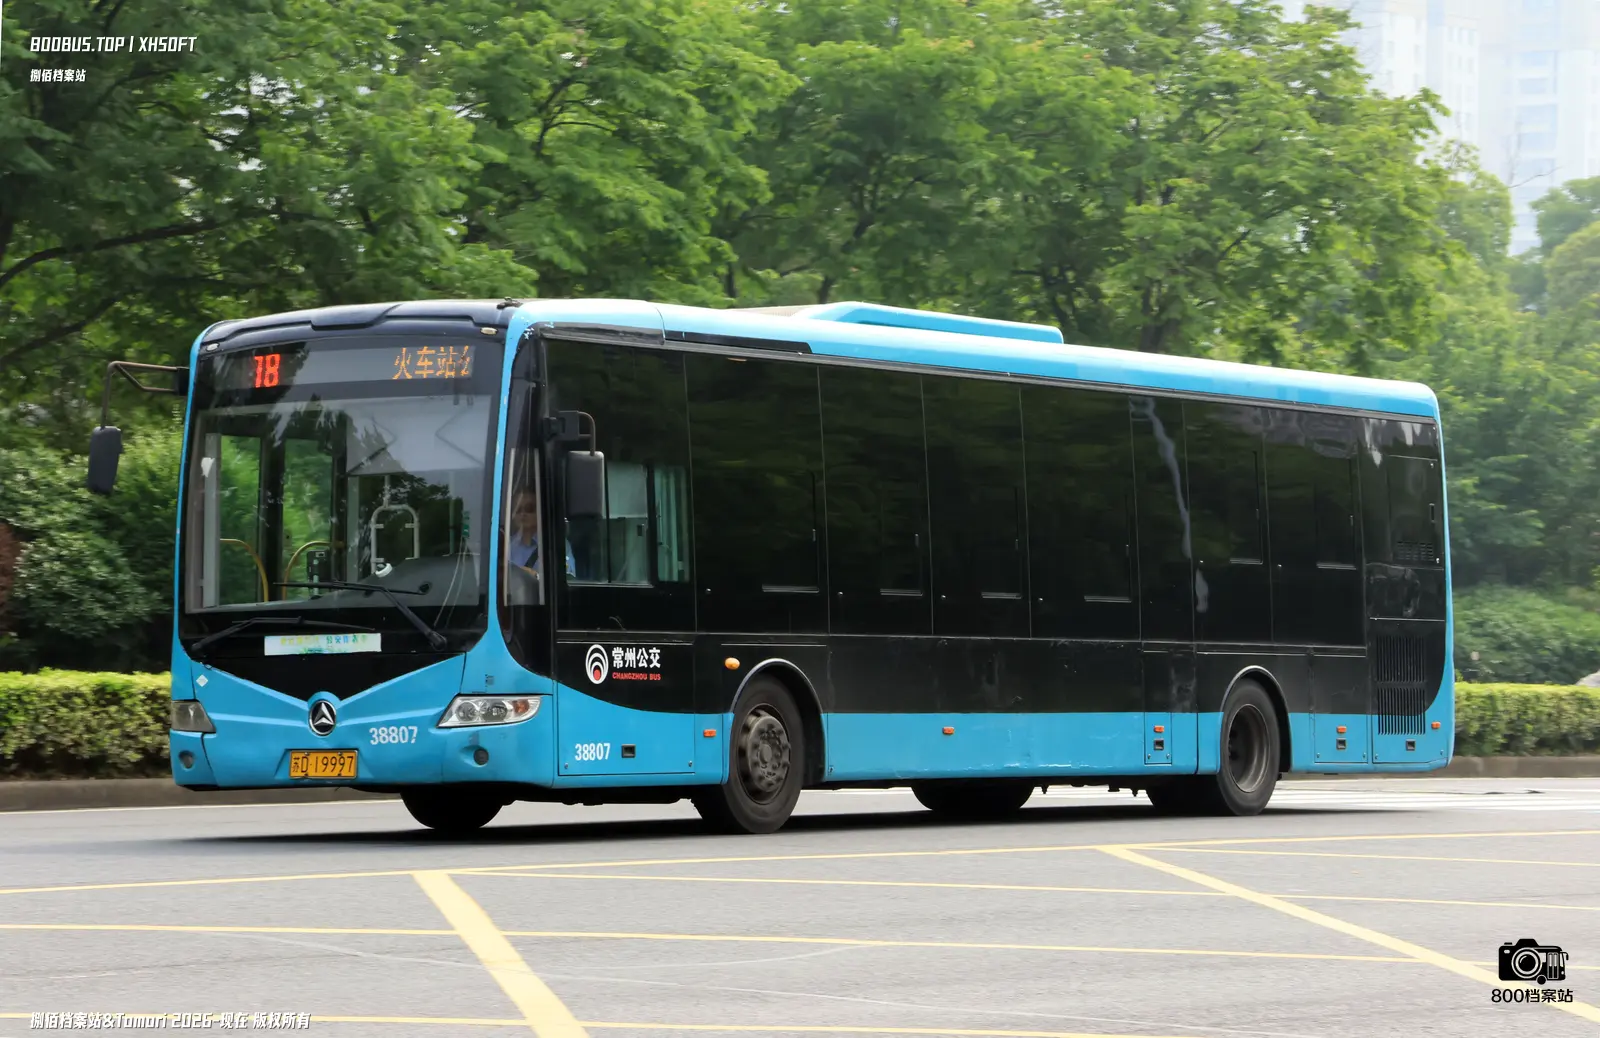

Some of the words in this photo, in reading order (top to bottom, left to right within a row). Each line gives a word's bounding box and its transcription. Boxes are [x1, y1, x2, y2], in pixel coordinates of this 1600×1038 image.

[254, 353, 281, 389] 18
[611, 646, 661, 669] 常州公交
[611, 671, 648, 681] CHANGZHOU
[649, 673, 662, 681] BUS
[368, 725, 419, 745] 38807
[574, 742, 611, 762] 38807
